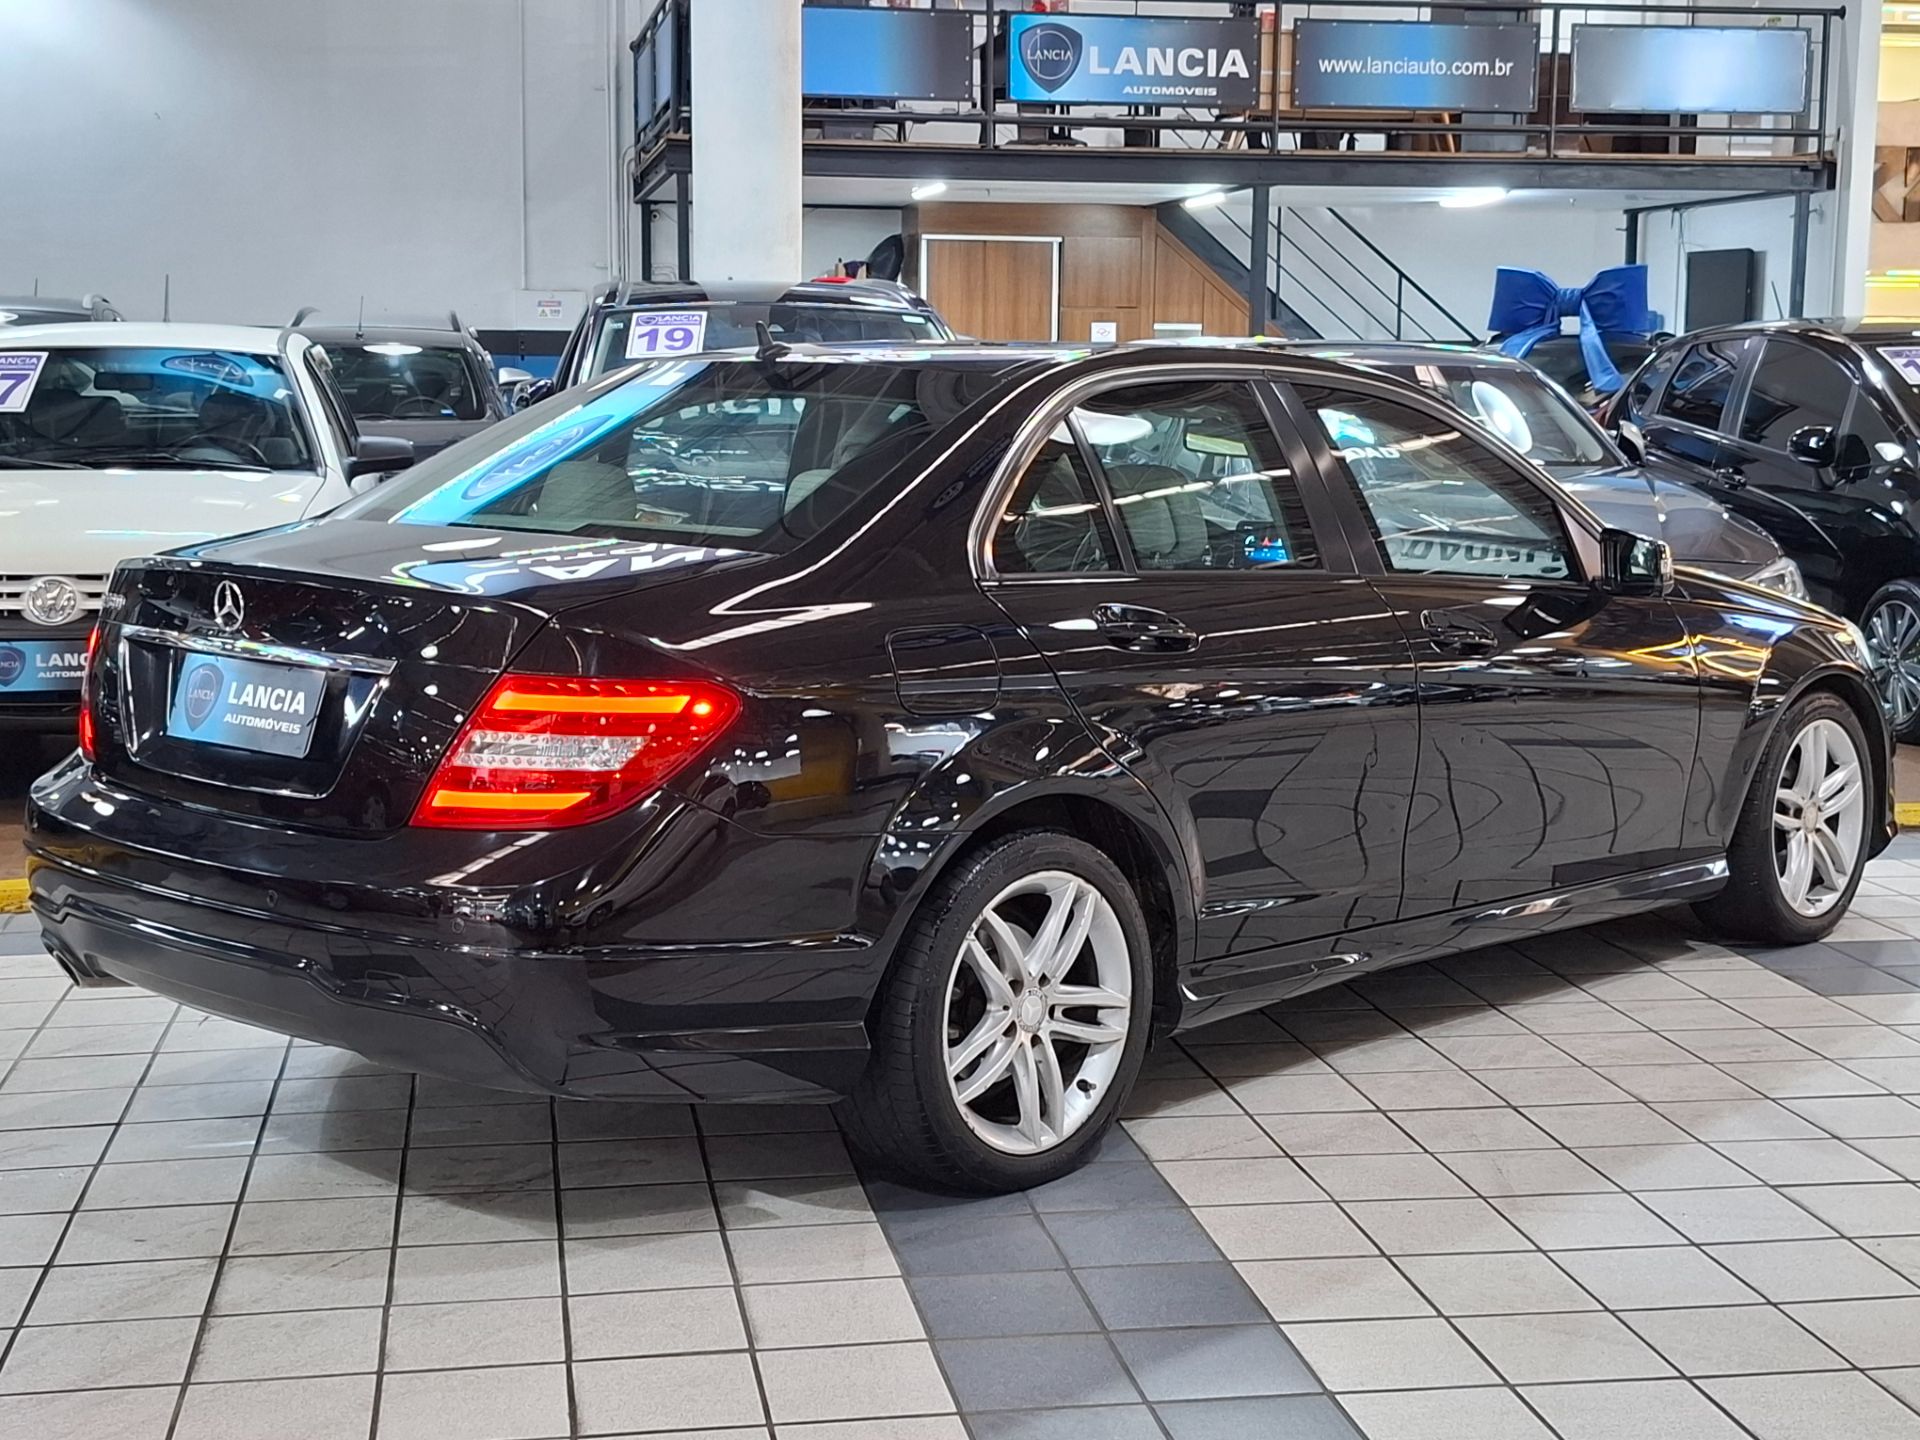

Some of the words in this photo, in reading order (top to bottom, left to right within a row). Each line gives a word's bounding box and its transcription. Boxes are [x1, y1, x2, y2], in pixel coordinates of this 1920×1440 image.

[1027, 49, 1073, 60] LANCIA
[1088, 46, 1250, 78] LANCIA
[1318, 56, 1514, 77] www.lanciauto.com.br
[1122, 85, 1218, 96] AUTOMÓVEIS
[637, 327, 694, 352] 19
[188, 687, 216, 701] LANCIA
[227, 681, 306, 716] LANCIA
[223, 713, 302, 735] AUTOMÓVEIS
